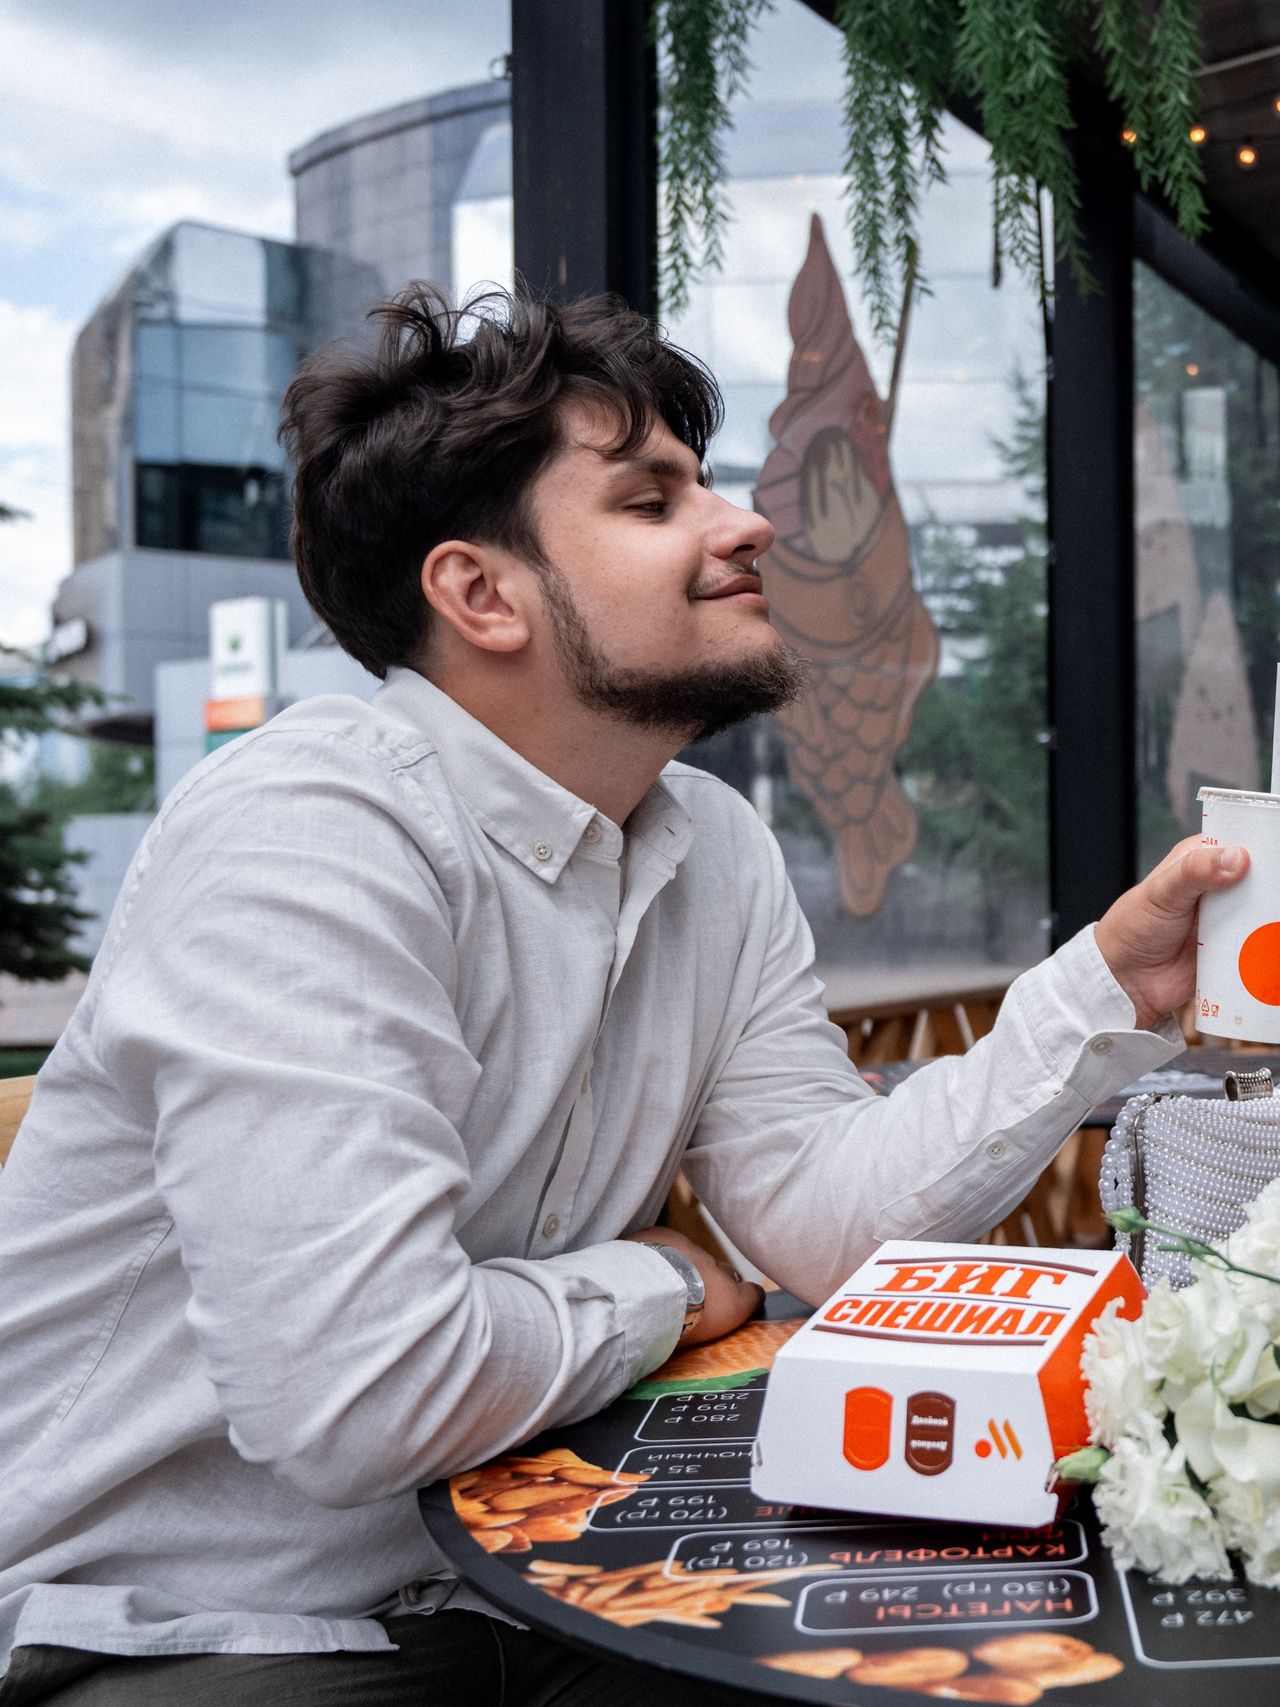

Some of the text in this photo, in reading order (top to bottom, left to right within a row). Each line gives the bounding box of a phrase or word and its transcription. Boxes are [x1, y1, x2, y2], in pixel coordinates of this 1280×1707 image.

[874, 1264, 1068, 1299] БИГ
[823, 1299, 1067, 1336] СПЕШИАЛ
[703, 1393, 749, 1401] 280
[698, 1403, 738, 1411] 199
[692, 1414, 740, 1423] 280
[911, 1415, 949, 1427] Двойной
[668, 1465, 702, 1474] 35
[668, 1495, 715, 1506] 199
[615, 1507, 727, 1523] (170 гр)
[742, 1538, 793, 1552] 169
[686, 1543, 1066, 1572] КАРТОФЕЛЬ (120 гр)
[859, 1585, 918, 1604] 249
[942, 1581, 991, 1600] гр)
[1002, 1578, 1071, 1598] (130
[876, 1598, 1073, 1621] НАГЕТСЫ
[1194, 1609, 1255, 1628] 472
